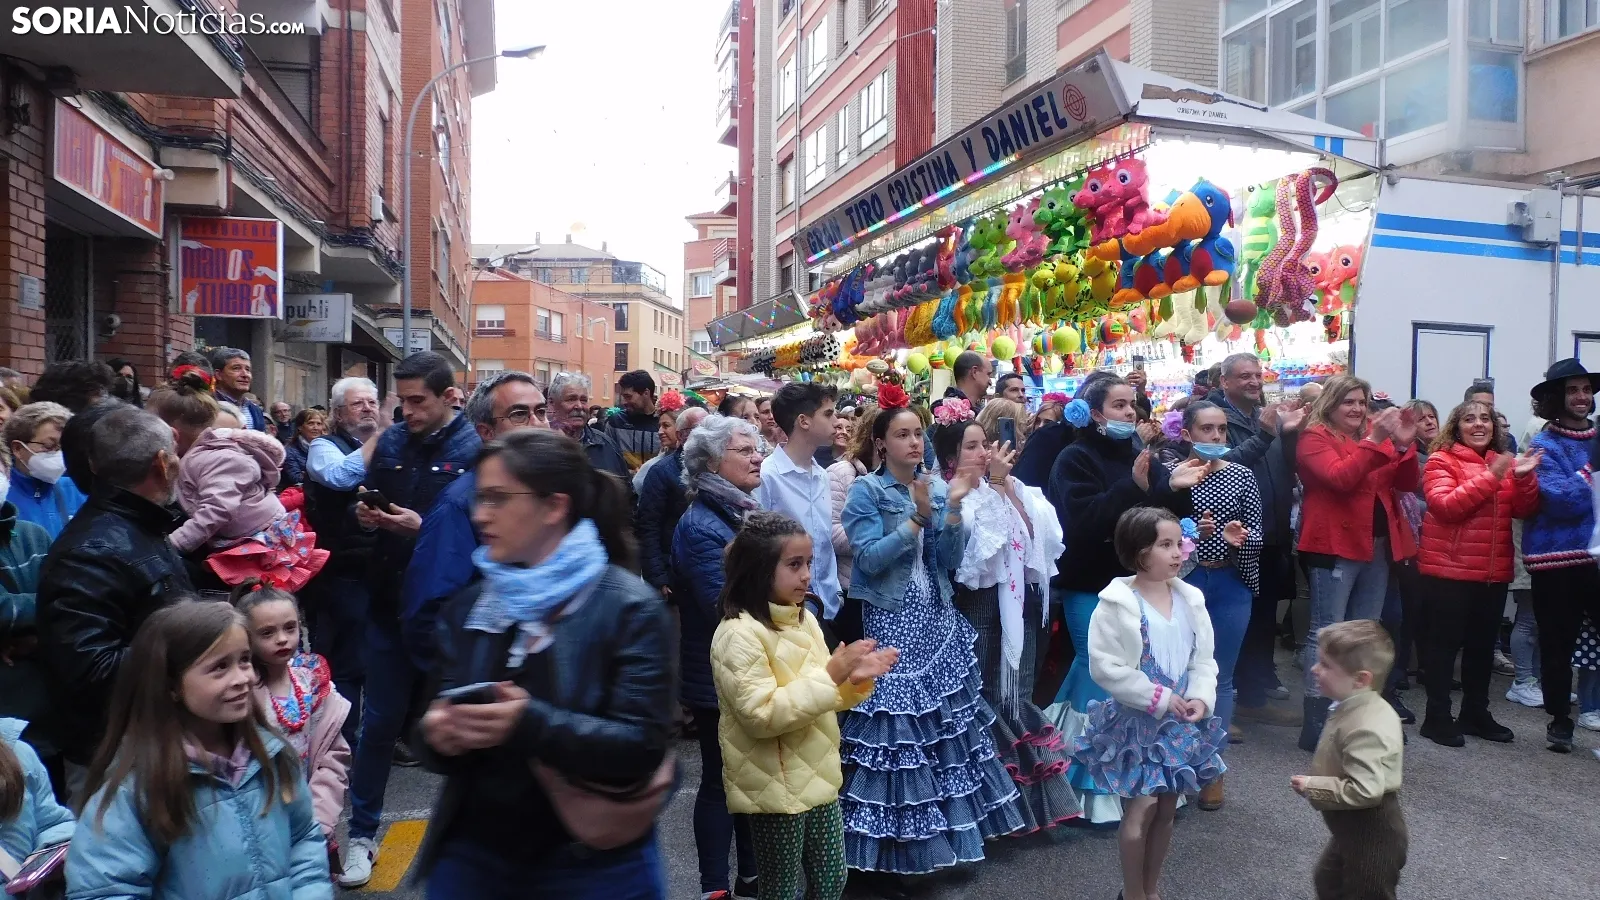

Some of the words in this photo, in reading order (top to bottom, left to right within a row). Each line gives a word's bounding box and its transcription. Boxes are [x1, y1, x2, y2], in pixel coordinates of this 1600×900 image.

[806, 216, 843, 254] GRAN
[845, 192, 885, 234] TIRO
[887, 149, 961, 213] CRISTINA
[960, 137, 977, 172] Y
[981, 91, 1068, 162] DANIEL
[286, 300, 329, 324] publi
